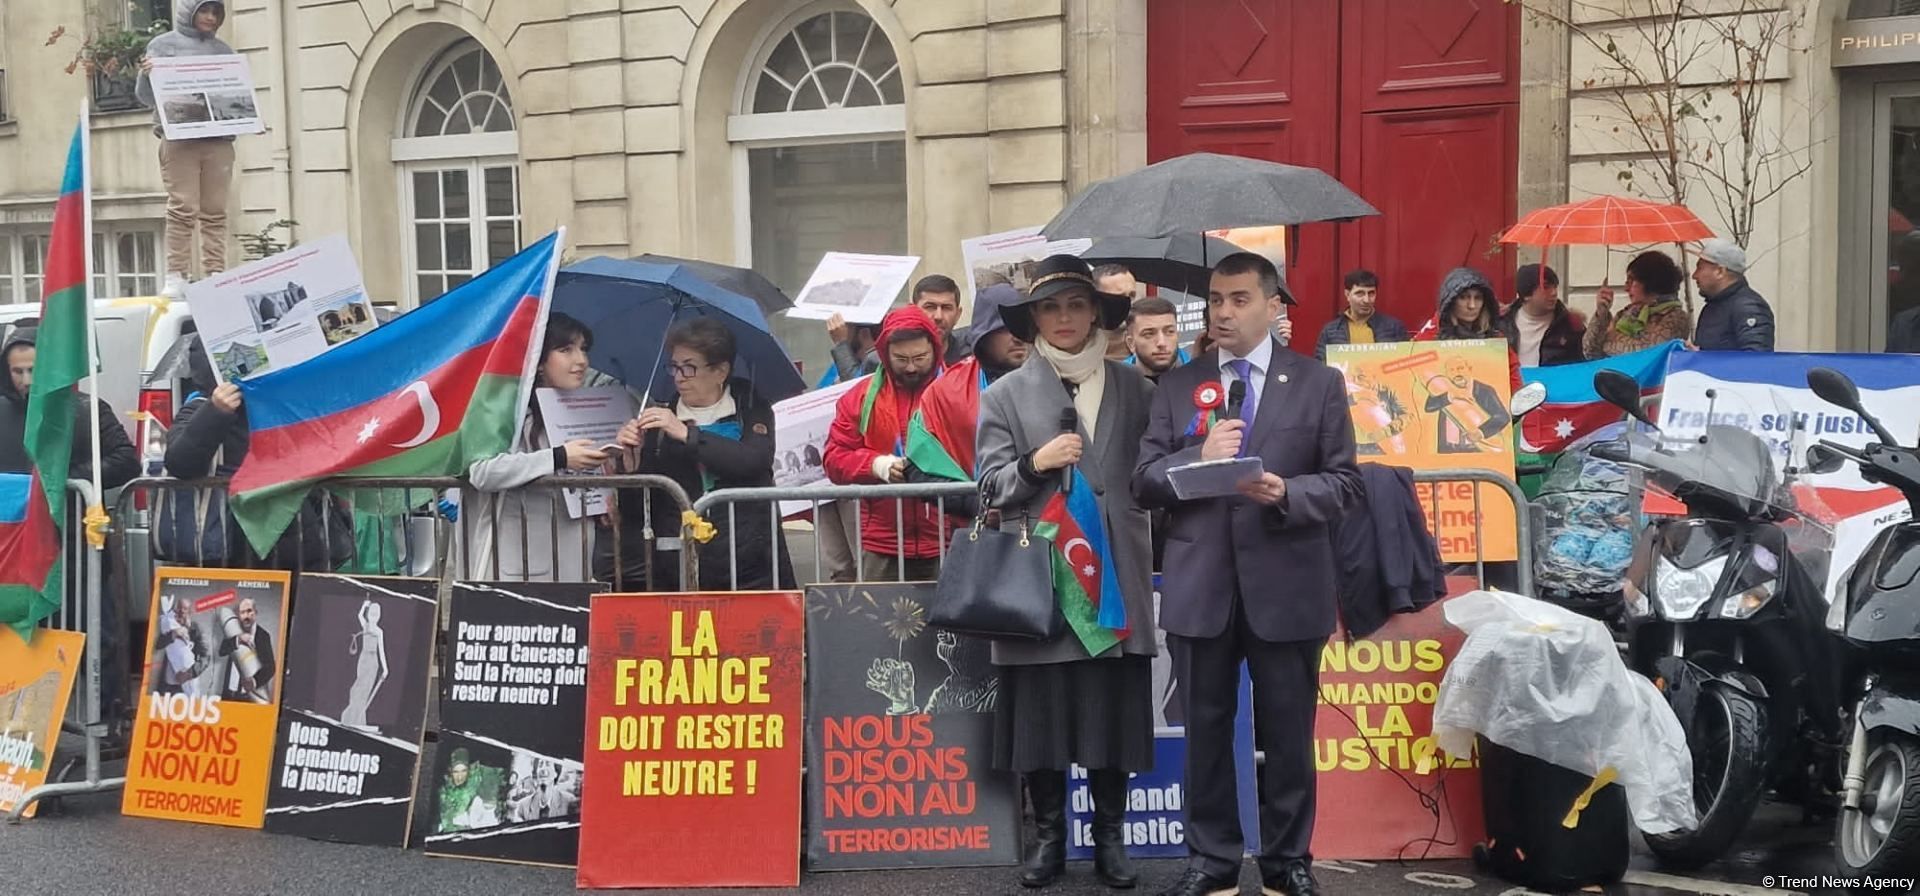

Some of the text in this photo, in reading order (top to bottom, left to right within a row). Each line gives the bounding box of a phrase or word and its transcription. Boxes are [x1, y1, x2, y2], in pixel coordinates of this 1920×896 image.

[1841, 32, 1920, 50] PHILIP
[1448, 482, 1472, 499] le
[458, 621, 576, 643] Pour apporter la
[671, 610, 718, 657] LA
[456, 641, 488, 661] Paix
[489, 645, 509, 662] au
[511, 643, 575, 664] Caucase
[1319, 639, 1444, 673] NOUS
[454, 661, 586, 686] Sud la France doit
[615, 657, 770, 705] FRANCE
[150, 691, 222, 724] NOUS
[451, 684, 559, 705] rester neutre !
[289, 722, 329, 747] Nous
[599, 714, 784, 751] DOIT RESTER
[823, 714, 934, 749] NOUS
[1355, 705, 1413, 737] LA
[145, 721, 239, 756] DISONS
[140, 751, 240, 786] NON AU
[285, 744, 380, 775] demandons
[824, 747, 968, 784] DISONS
[281, 765, 365, 796] la justice!
[623, 759, 757, 796] NEUTRE !
[136, 789, 243, 818] TERRORISME
[825, 781, 976, 819] NON AU
[823, 825, 990, 853] TERRORISME
